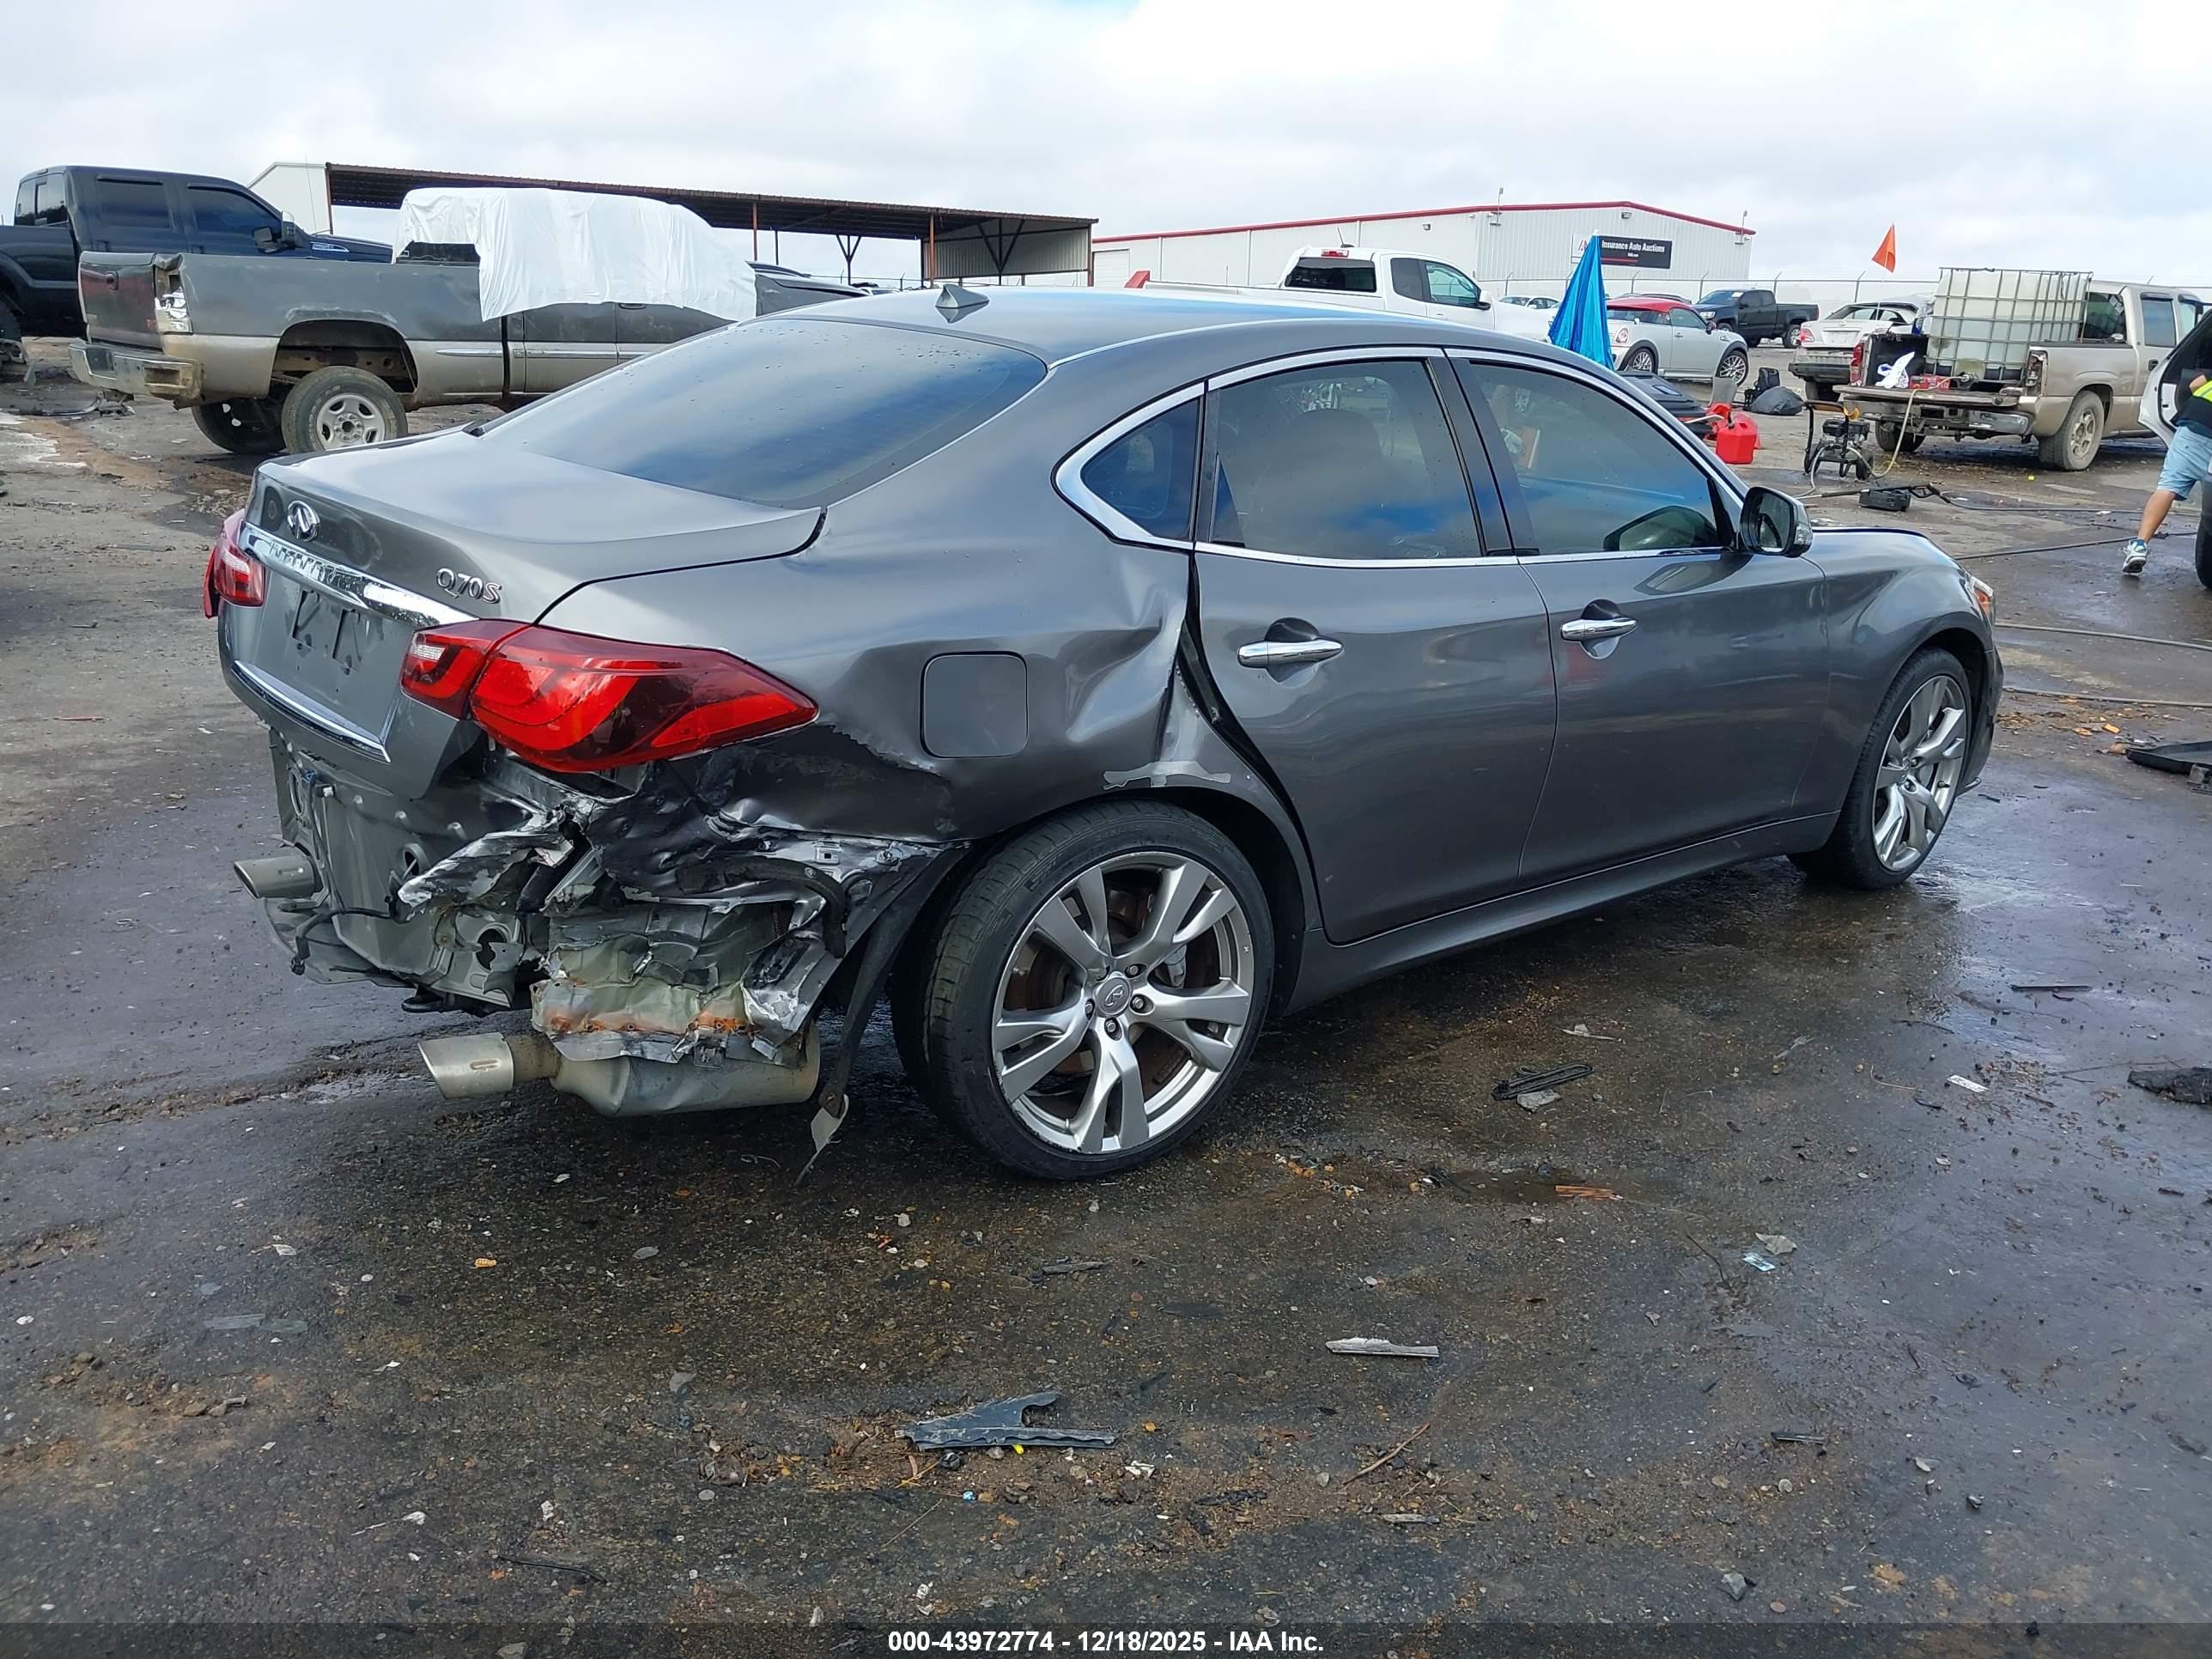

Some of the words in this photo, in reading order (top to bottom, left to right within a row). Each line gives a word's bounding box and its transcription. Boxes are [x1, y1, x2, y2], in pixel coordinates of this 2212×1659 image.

[1601, 240, 1629, 250] Insurance
[1629, 241, 1642, 251] Auto
[1642, 242, 1666, 253] Auctions
[436, 568, 502, 604] Q70S
